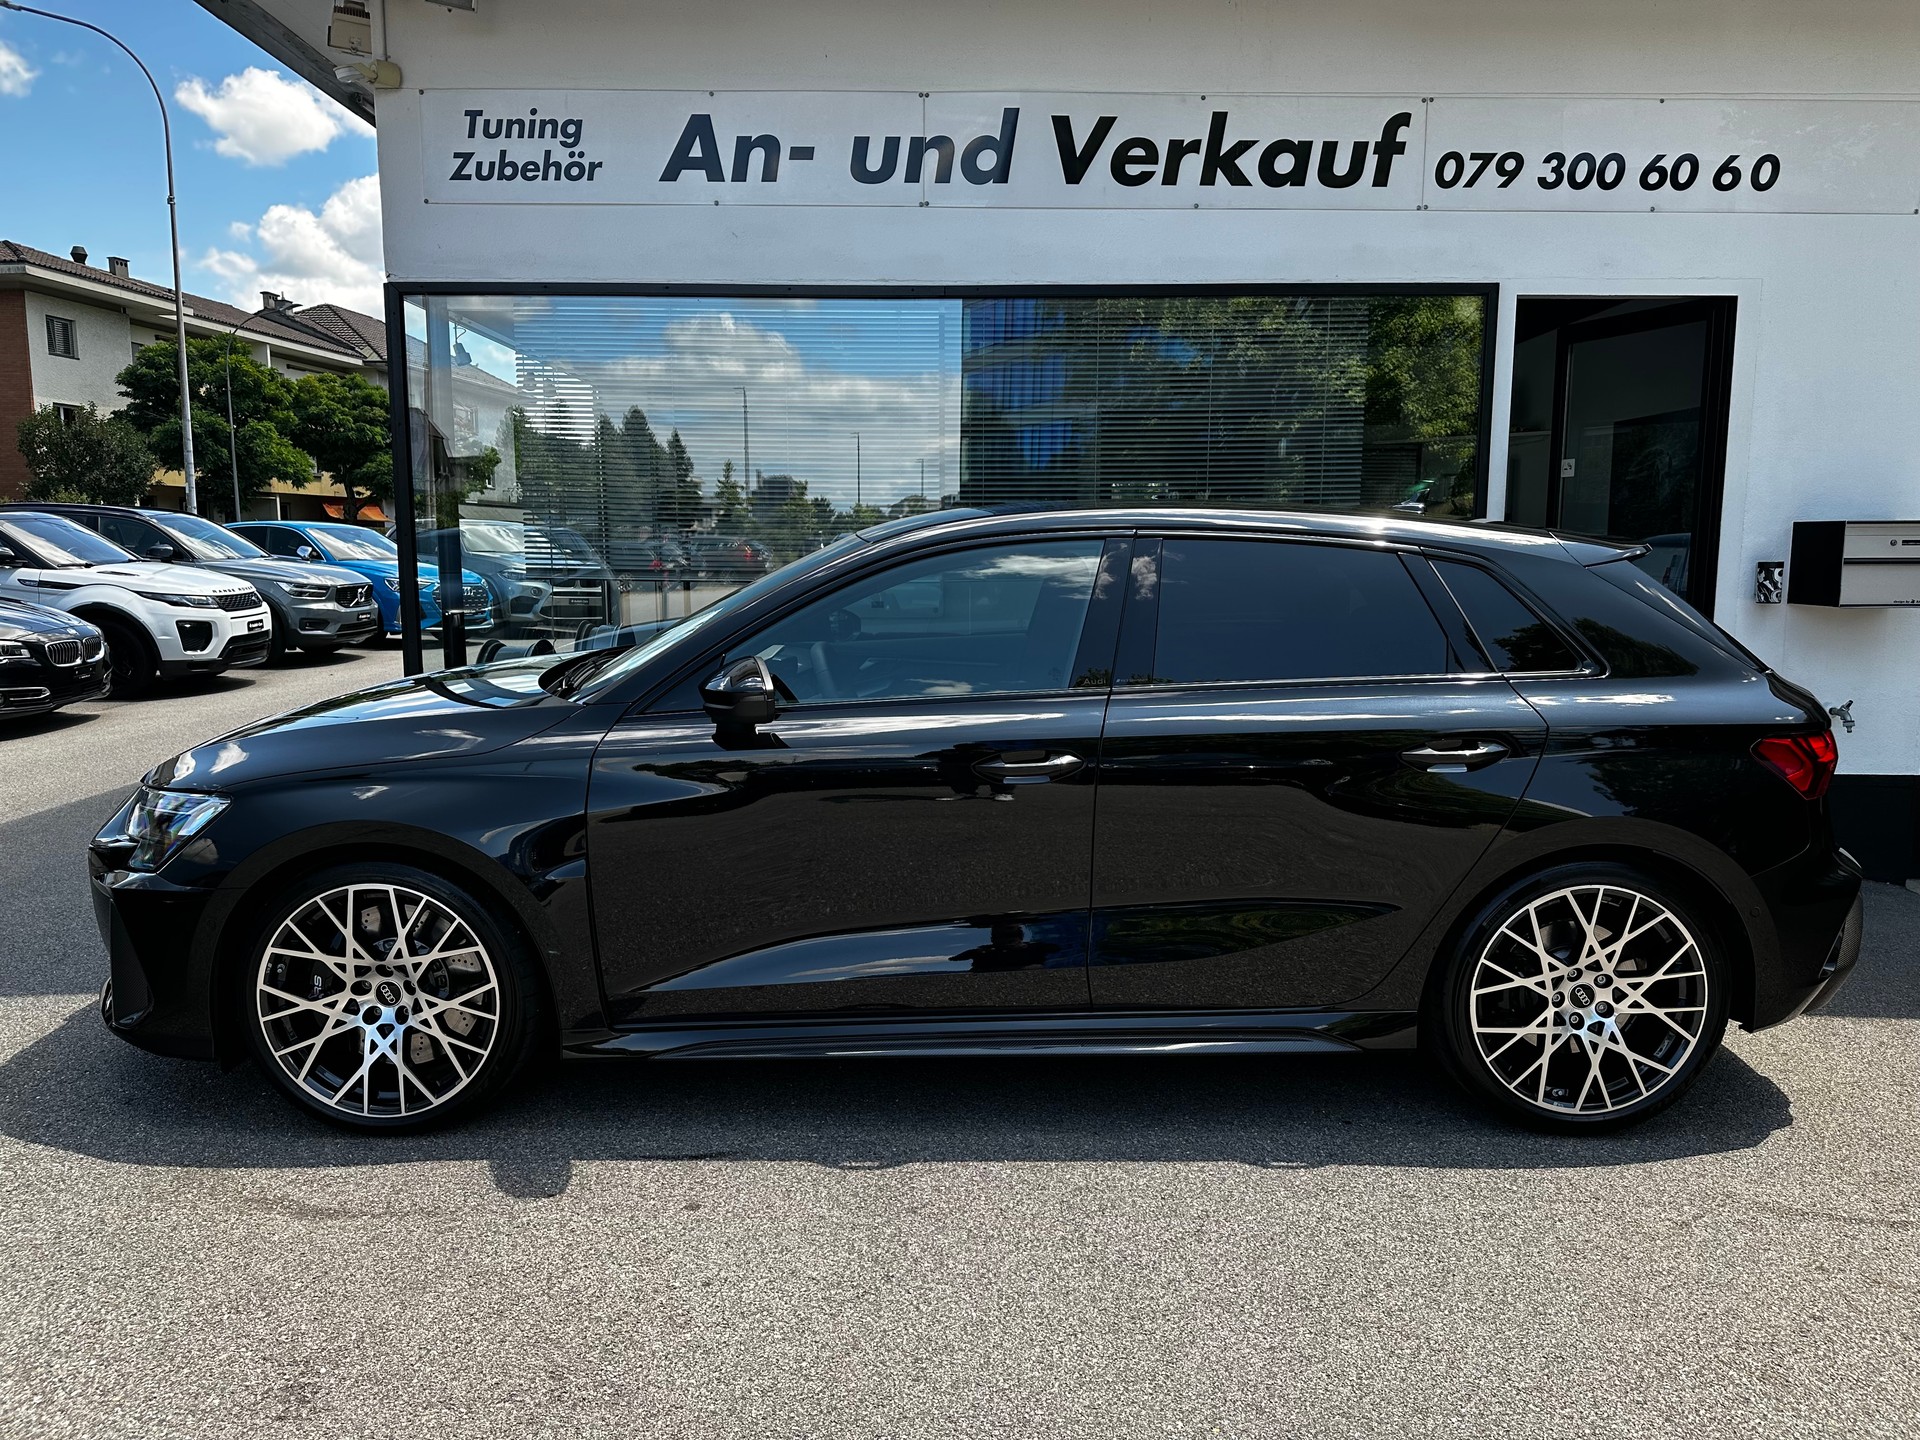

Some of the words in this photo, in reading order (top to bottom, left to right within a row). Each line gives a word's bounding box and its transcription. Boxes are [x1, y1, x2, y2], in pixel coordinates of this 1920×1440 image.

[463, 107, 584, 149] Tuning
[658, 113, 816, 184] An-
[849, 107, 1021, 186] und
[1050, 110, 1413, 189] Verkauf
[448, 149, 604, 182] Zubehör
[1434, 150, 1525, 190] 079
[1537, 151, 1626, 191] 300
[1638, 152, 1700, 192] 60
[1083, 678, 1106, 686] Audi
